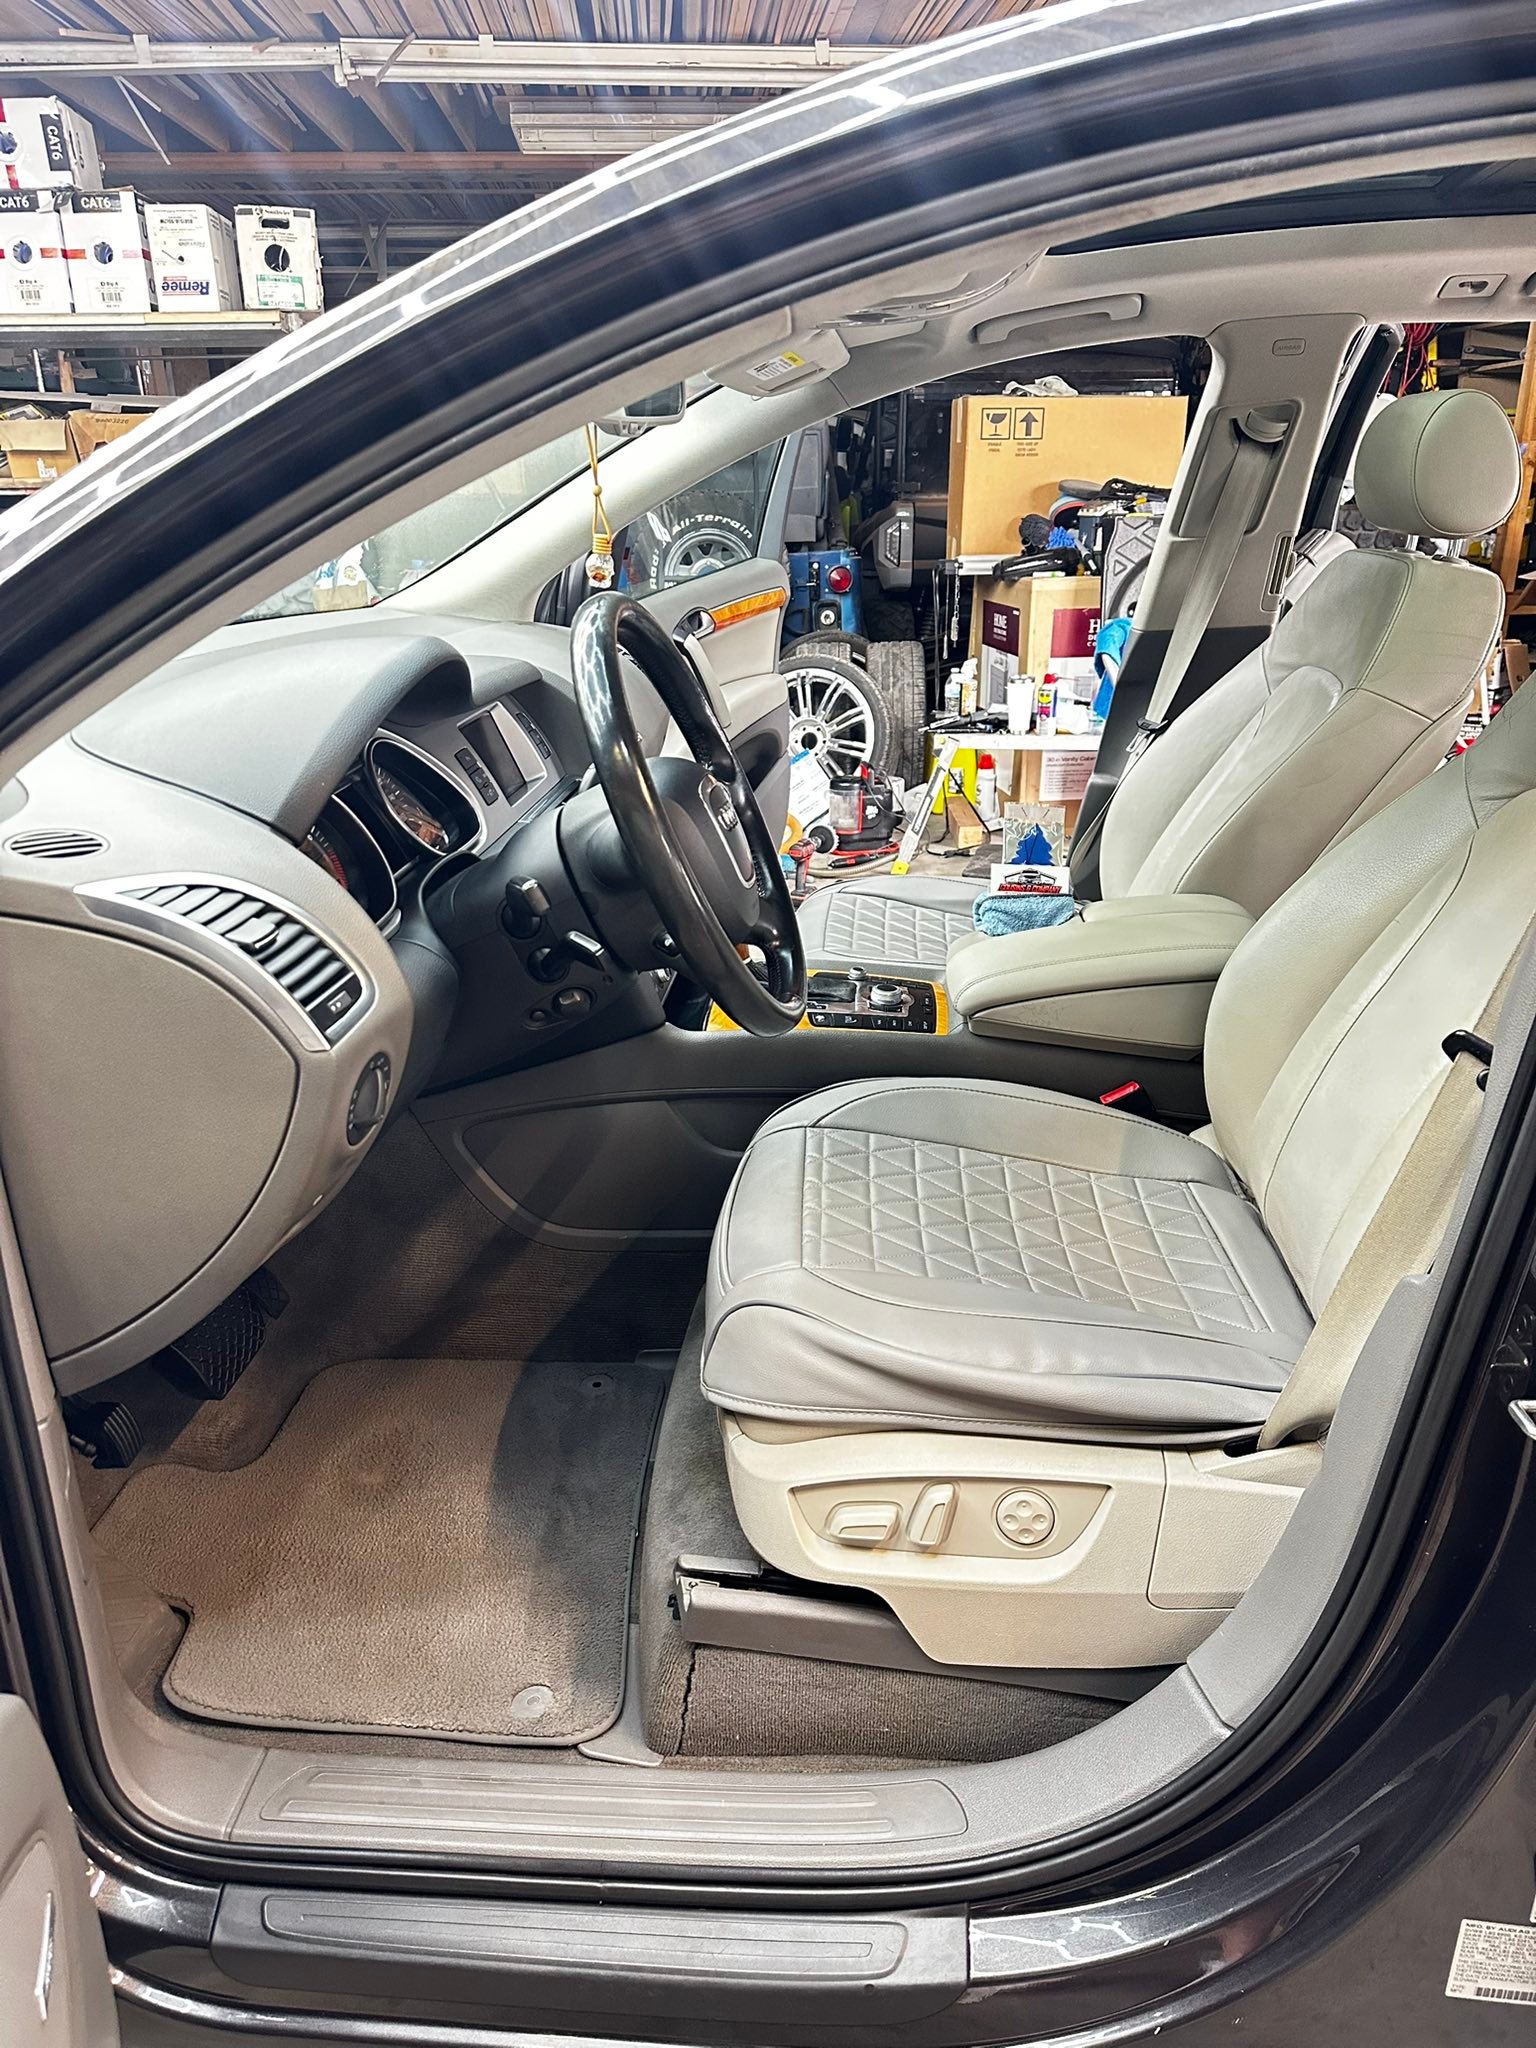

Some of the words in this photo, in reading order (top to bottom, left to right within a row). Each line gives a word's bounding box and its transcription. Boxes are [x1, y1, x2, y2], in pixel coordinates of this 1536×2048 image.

[46, 125, 64, 161] CAT6
[0, 196, 30, 208] CAT6
[81, 196, 112, 209] CAT6
[161, 281, 210, 295] Remee
[672, 513, 753, 539] All-Terrain
